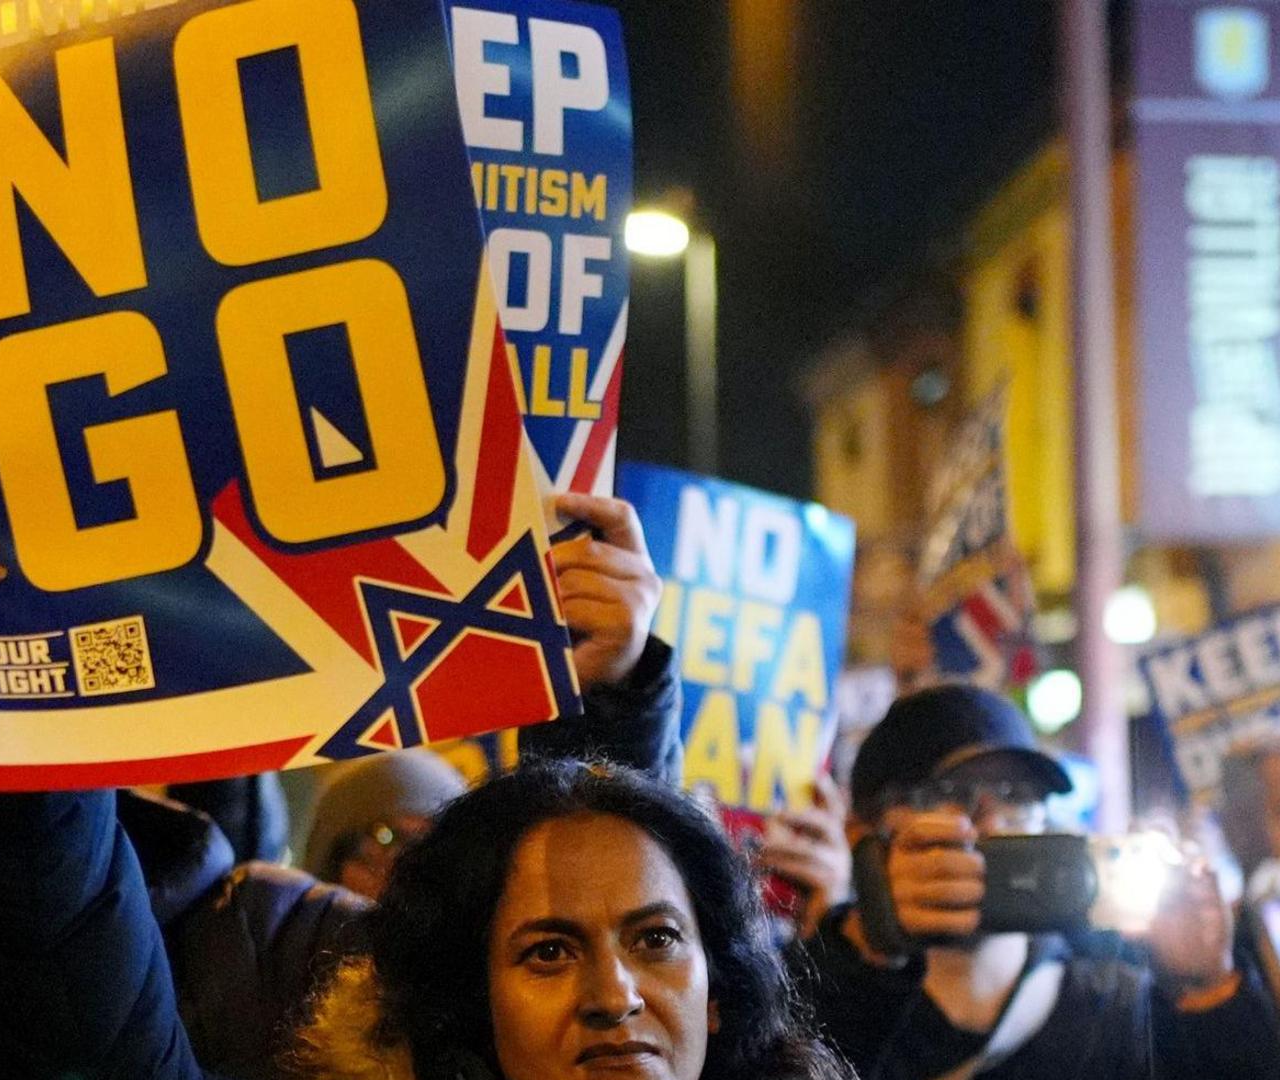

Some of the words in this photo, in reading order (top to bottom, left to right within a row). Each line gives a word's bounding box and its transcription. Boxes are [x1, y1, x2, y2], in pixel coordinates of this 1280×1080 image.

[451, 7, 610, 156] EP
[488, 228, 612, 335] OF
[674, 484, 803, 604] NO
[681, 687, 821, 816] AN
